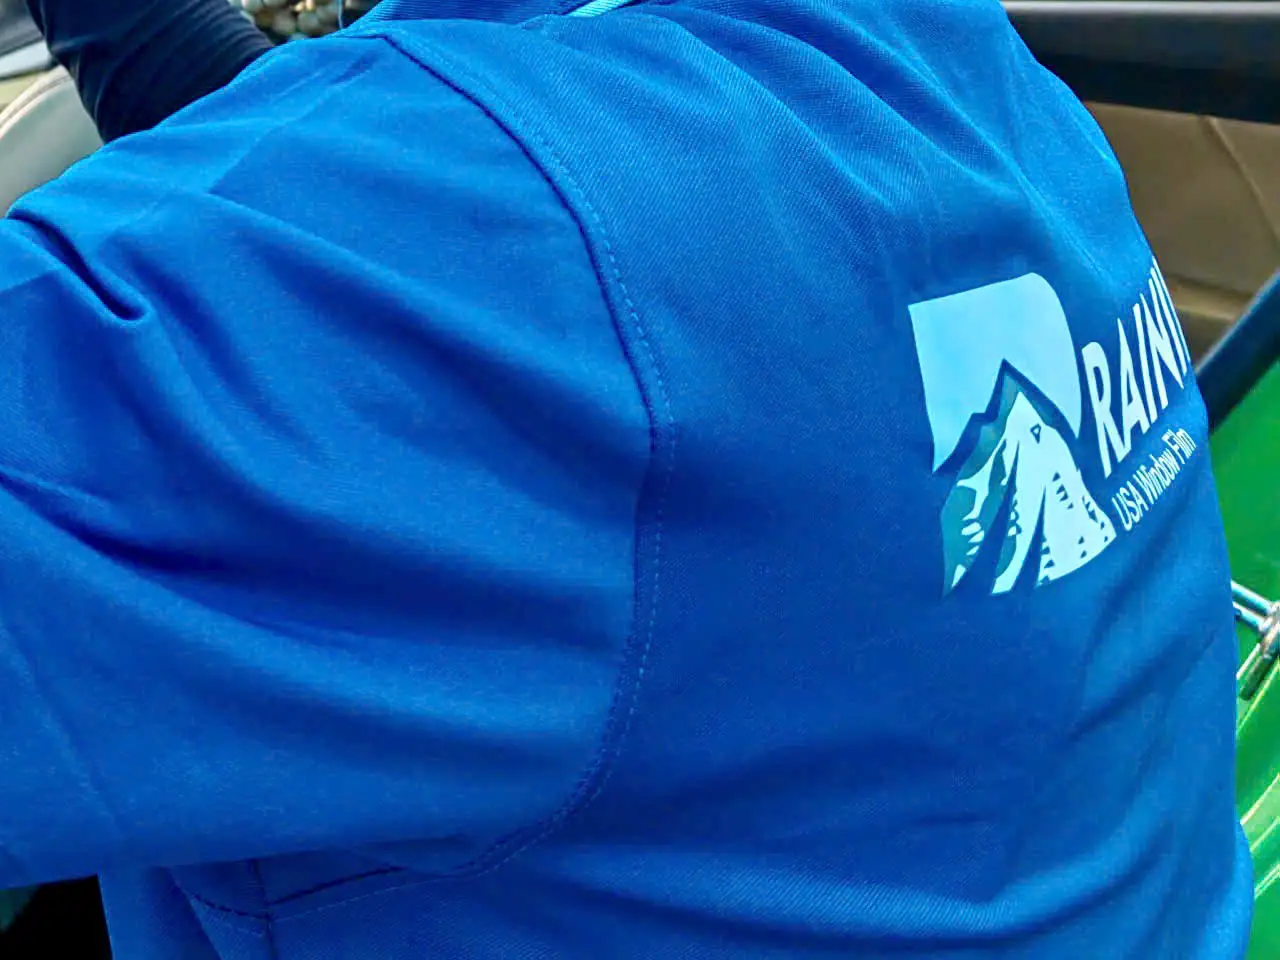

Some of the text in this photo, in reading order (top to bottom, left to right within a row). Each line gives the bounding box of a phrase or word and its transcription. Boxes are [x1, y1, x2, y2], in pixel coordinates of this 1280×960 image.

[1111, 428, 1197, 531] USA Window Film
